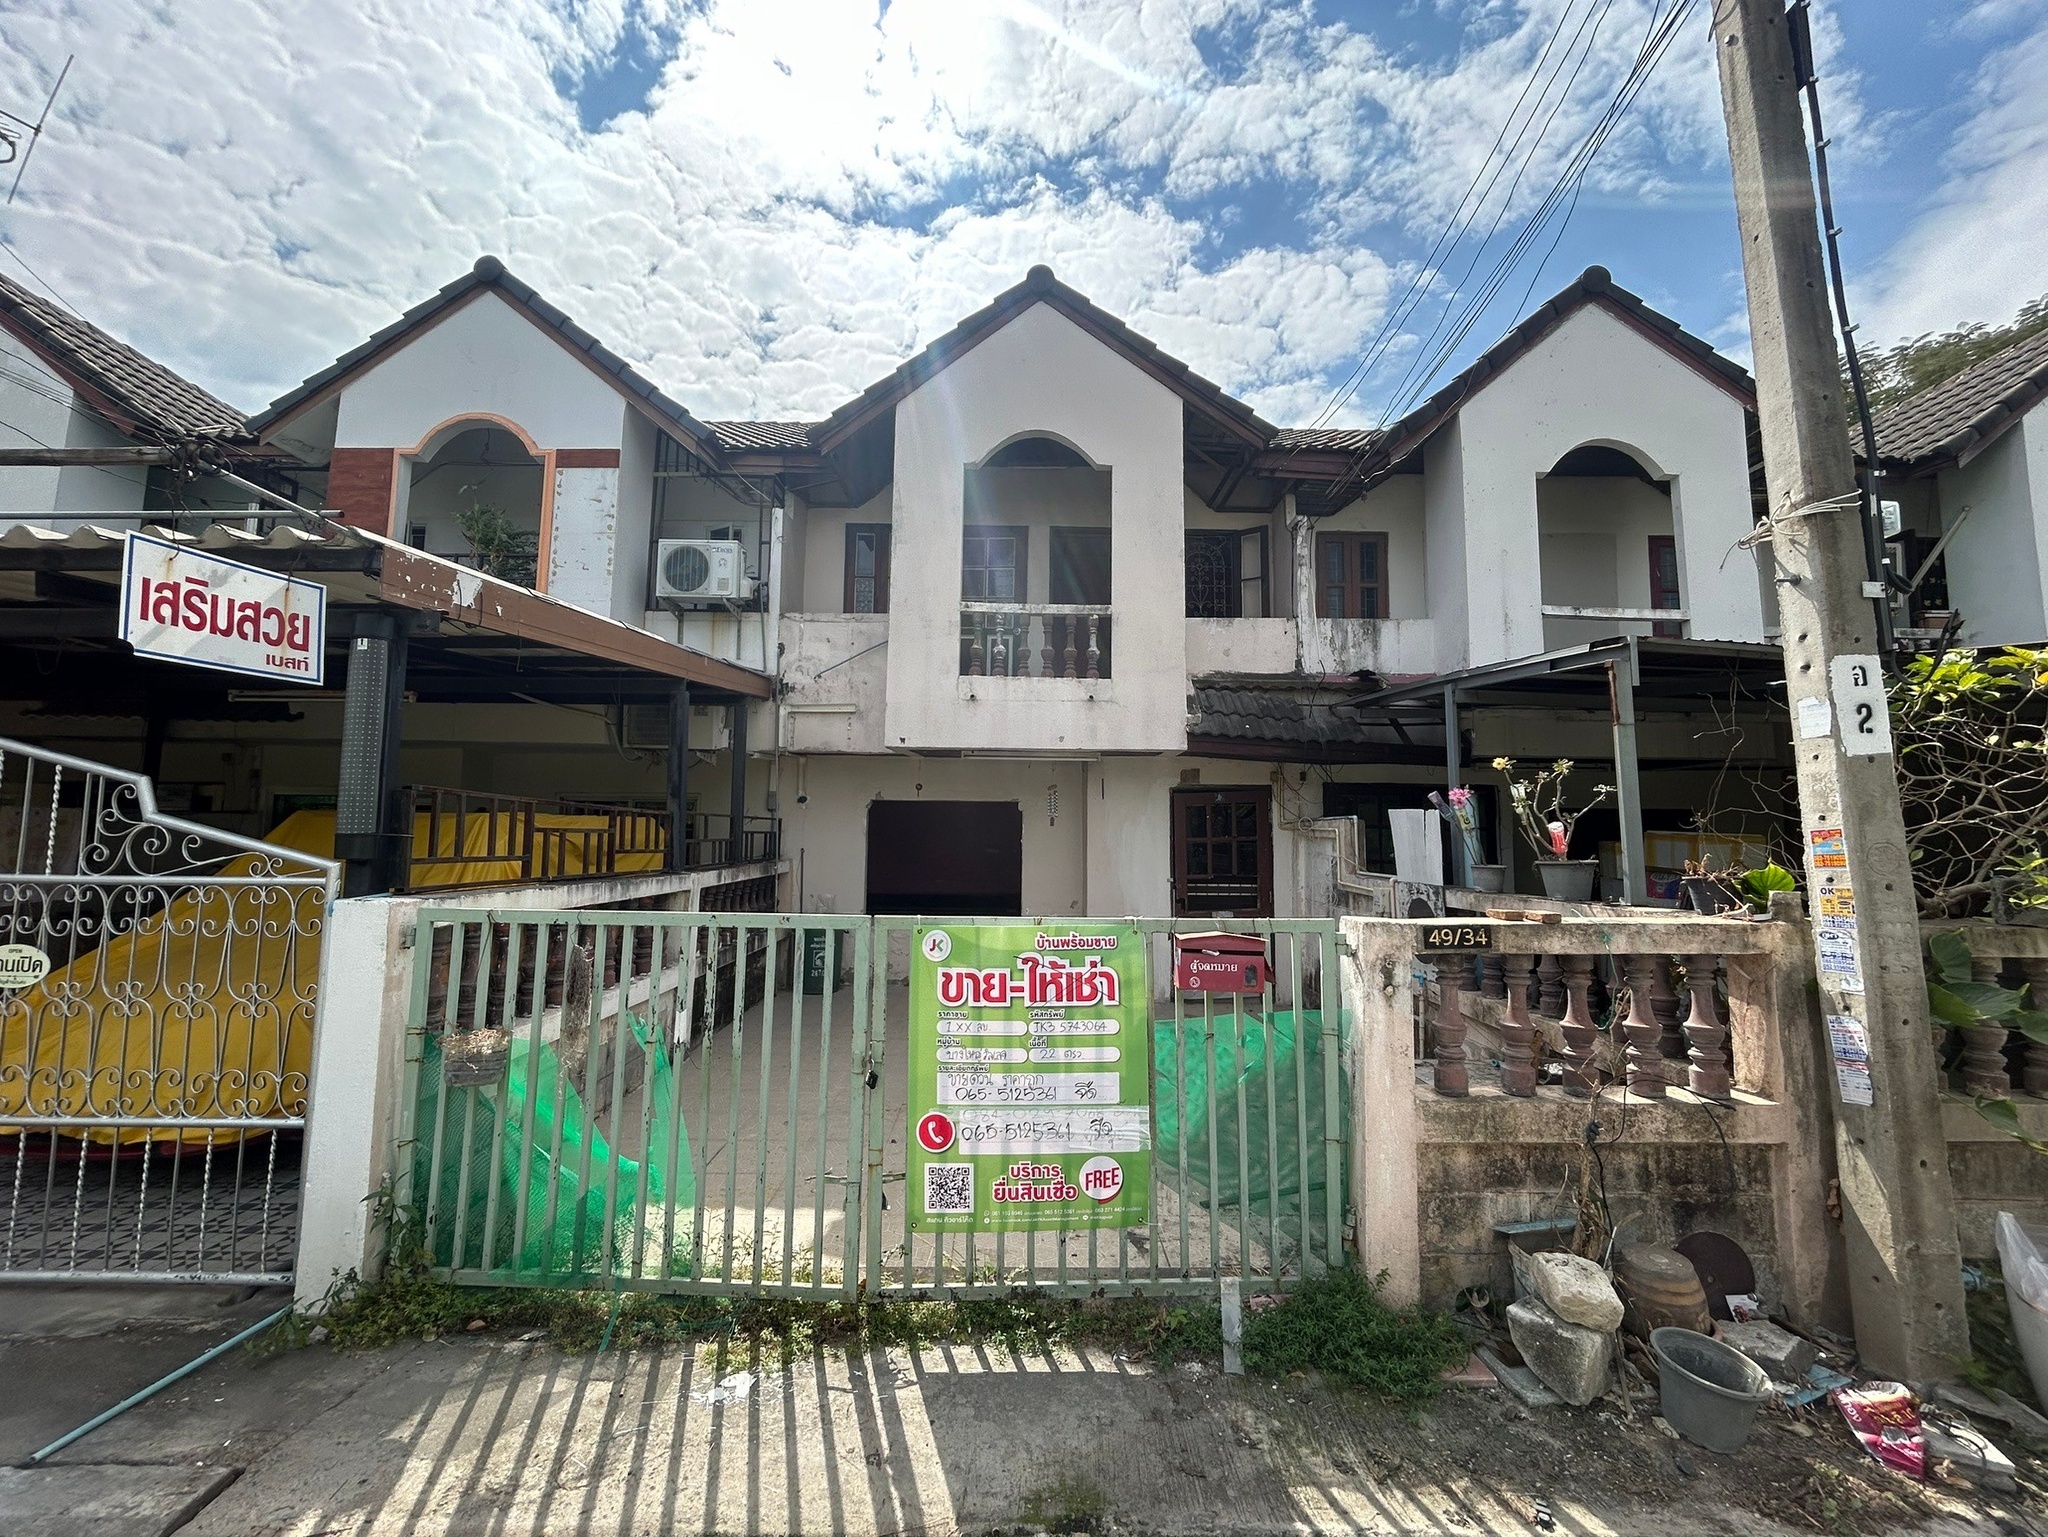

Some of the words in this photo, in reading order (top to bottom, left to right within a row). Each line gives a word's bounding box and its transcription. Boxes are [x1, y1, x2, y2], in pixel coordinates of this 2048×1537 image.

[139, 576, 311, 652] เสริมสวย
[265, 654, 309, 671] เบสท์
[1856, 703, 1874, 734] 2
[1820, 887, 1835, 895] OK
[1428, 928, 1488, 946] 49/34
[0, 955, 43, 973] านเปิด
[1190, 959, 1238, 974] ตู้จดหมาย
[1029, 1008, 1064, 1018] รหัสทรัพย์
[1059, 1020, 1108, 1033] 5743064
[1039, 1048, 1056, 1059] 22
[1010, 1162, 1061, 1178] บริการ
[1084, 1166, 1120, 1191] FREE
[993, 1176, 1078, 1200] ยื่นสินเชื่อ
